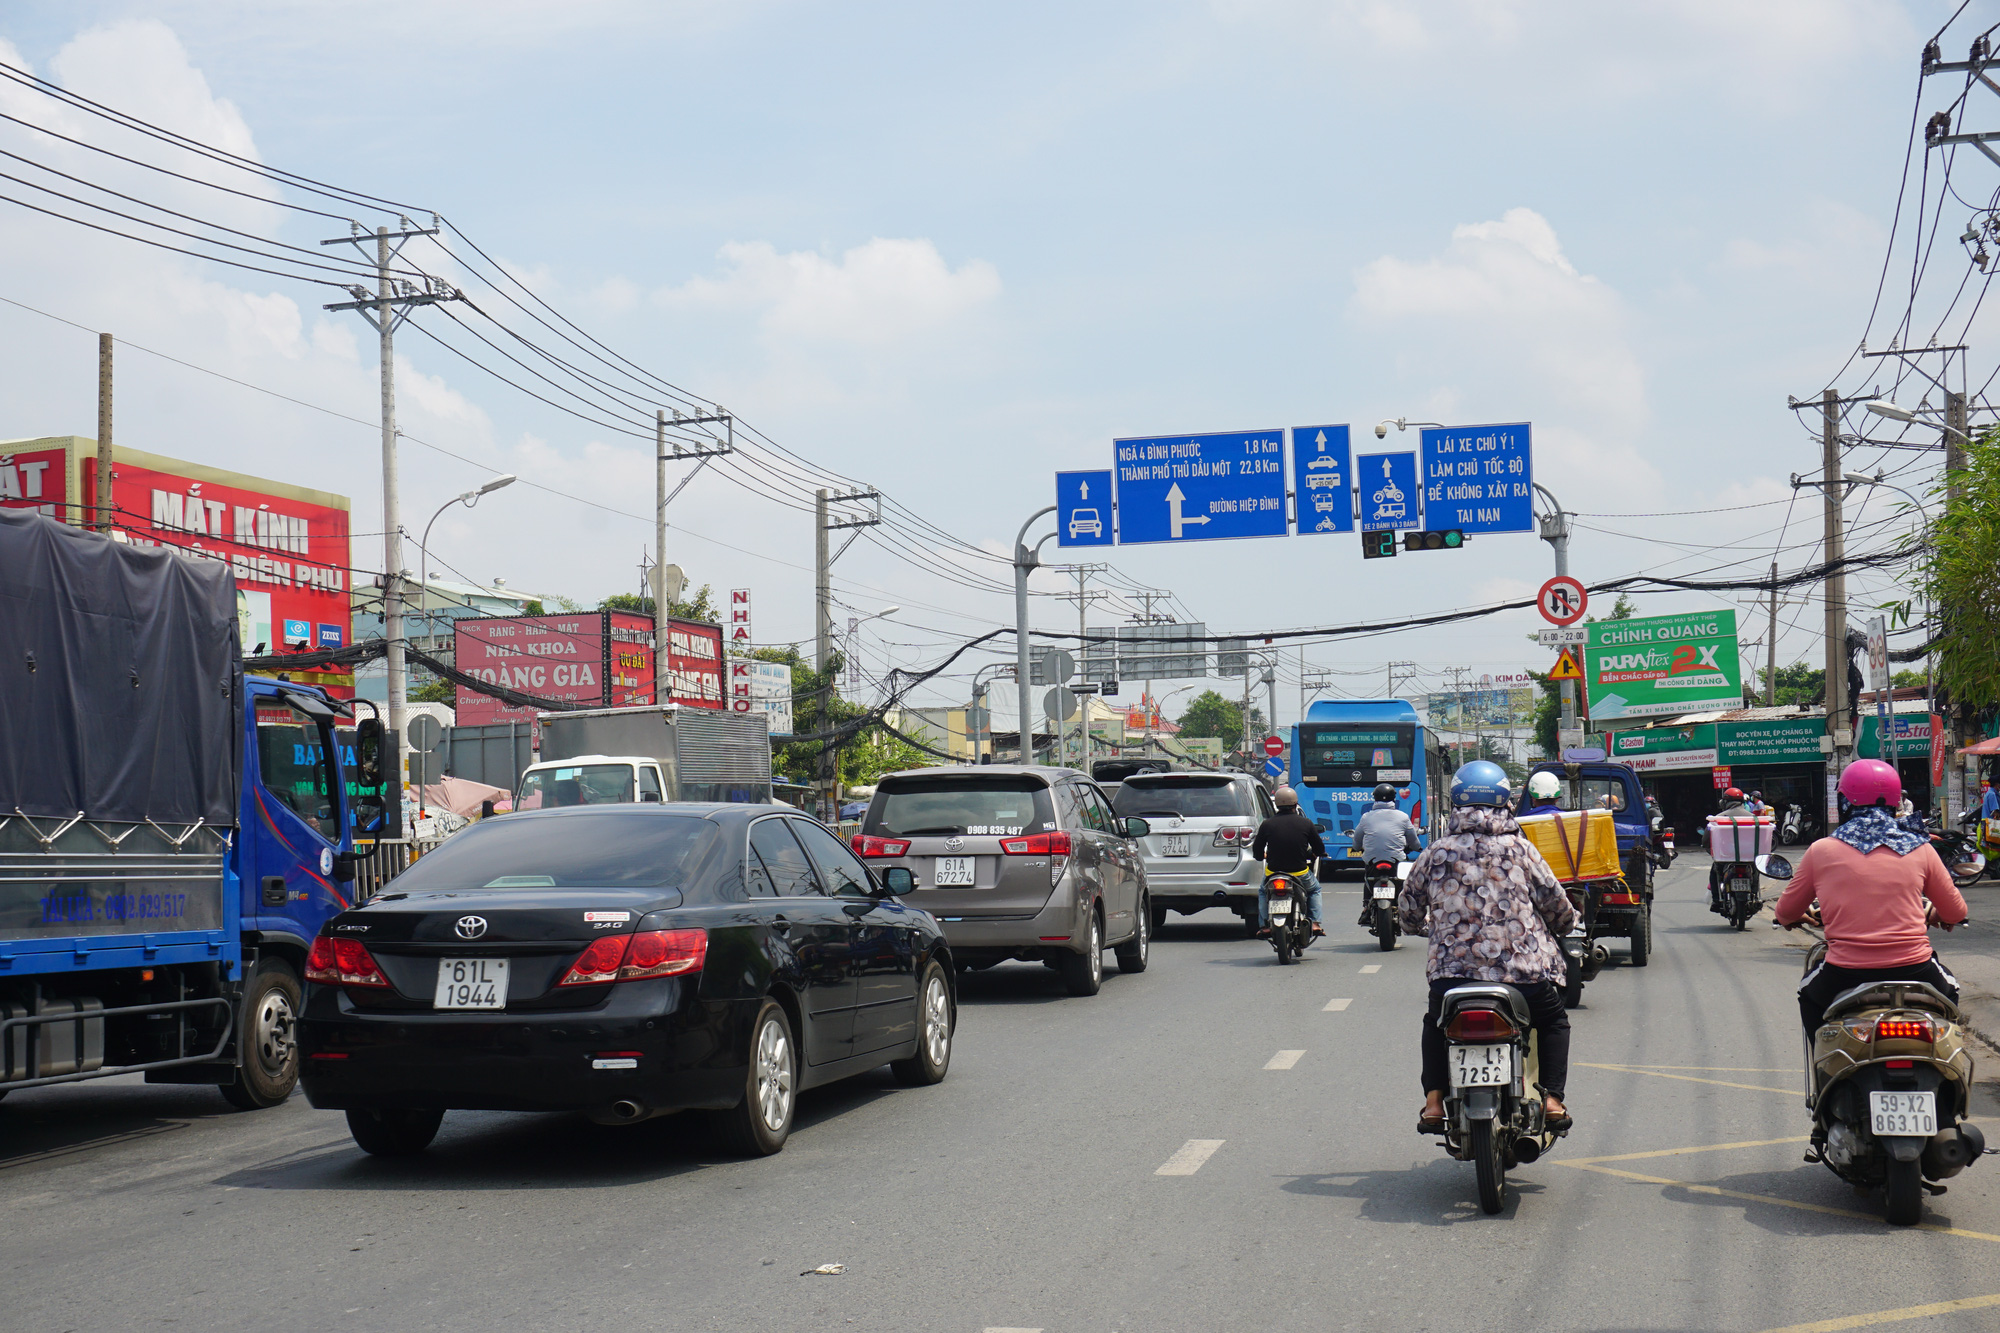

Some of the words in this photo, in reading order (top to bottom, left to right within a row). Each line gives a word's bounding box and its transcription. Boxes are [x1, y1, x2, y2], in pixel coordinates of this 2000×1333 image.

[1119, 445, 1138, 461] NGÃ
[1140, 447, 1146, 460] 4
[1147, 443, 1169, 460] BÌNH
[1171, 440, 1201, 458] PHƯỚC
[1244, 440, 1259, 455] 1,8
[1262, 439, 1278, 453] Km
[1437, 435, 1454, 454] LÁI
[1459, 438, 1472, 452] XE
[1476, 433, 1496, 451] CHÚ
[1500, 432, 1508, 450] Ý
[1121, 464, 1150, 482] THÀNH
[1152, 460, 1170, 479] PHỐ
[1172, 461, 1190, 478] THỦ
[1192, 458, 1210, 477] DẦU
[1212, 460, 1231, 477] MỘT
[1240, 461, 1261, 476] 22,8
[1262, 459, 1279, 473] Km
[1430, 462, 1454, 478] LÀM
[1458, 458, 1478, 476] CHỦ
[1484, 456, 1504, 474] TỐC
[1508, 456, 1524, 476] ĐỘ
[1428, 481, 1444, 501] ĐỂ
[1447, 482, 1482, 500] KHÔNG
[1488, 480, 1510, 498] XẢY
[1514, 482, 1528, 496] RA
[1209, 498, 1238, 514] ĐƯỜNG
[1240, 498, 1258, 514] HIỆP
[1260, 496, 1279, 512] BÌNH
[152, 483, 226, 538] MẮT
[233, 504, 308, 554] KÍNH
[1376, 521, 1390, 529] BÁNH
[1403, 519, 1417, 527] BÁNH
[1457, 509, 1472, 523] TAI
[1478, 508, 1500, 525] NẠN
[231, 554, 290, 586] BIÊN
[294, 564, 343, 592] PHỦ
[322, 631, 339, 641] ZEISS
[1600, 628, 1652, 644] CHÍNH
[1657, 623, 1718, 639] QUANG
[485, 644, 523, 658] NHA
[528, 642, 577, 655] KHOA
[670, 632, 690, 657] NHA
[690, 635, 715, 660] KHOA
[1670, 645, 1720, 675] 2X
[553, 664, 596, 687] GIA
[1602, 672, 1619, 682] BỀN
[1621, 671, 1642, 680] CHẮC
[1687, 677, 1695, 685] DỄ
[1698, 677, 1723, 685] DÀNG
[702, 673, 721, 701] GIA
[1625, 738, 1643, 747] Castrol
[293, 744, 316, 766] BA
[1636, 759, 1656, 770] HẠNH
[967, 826, 988, 834] 0908
[990, 826, 1005, 834] 835
[1007, 826, 1023, 835] 487
[1167, 834, 1182, 845] 51A
[1162, 845, 1188, 854] 374.44
[945, 858, 965, 871] 61A
[936, 872, 972, 884] 672.74
[67, 888, 93, 921] LÚA
[106, 894, 185, 920] 0902.629.517
[453, 961, 493, 984] 61L
[447, 985, 497, 1007] 1944
[1459, 1066, 1502, 1084] 7252
[1880, 1095, 1925, 1113] 59-X2
[1876, 1115, 1932, 1132] 863.10
